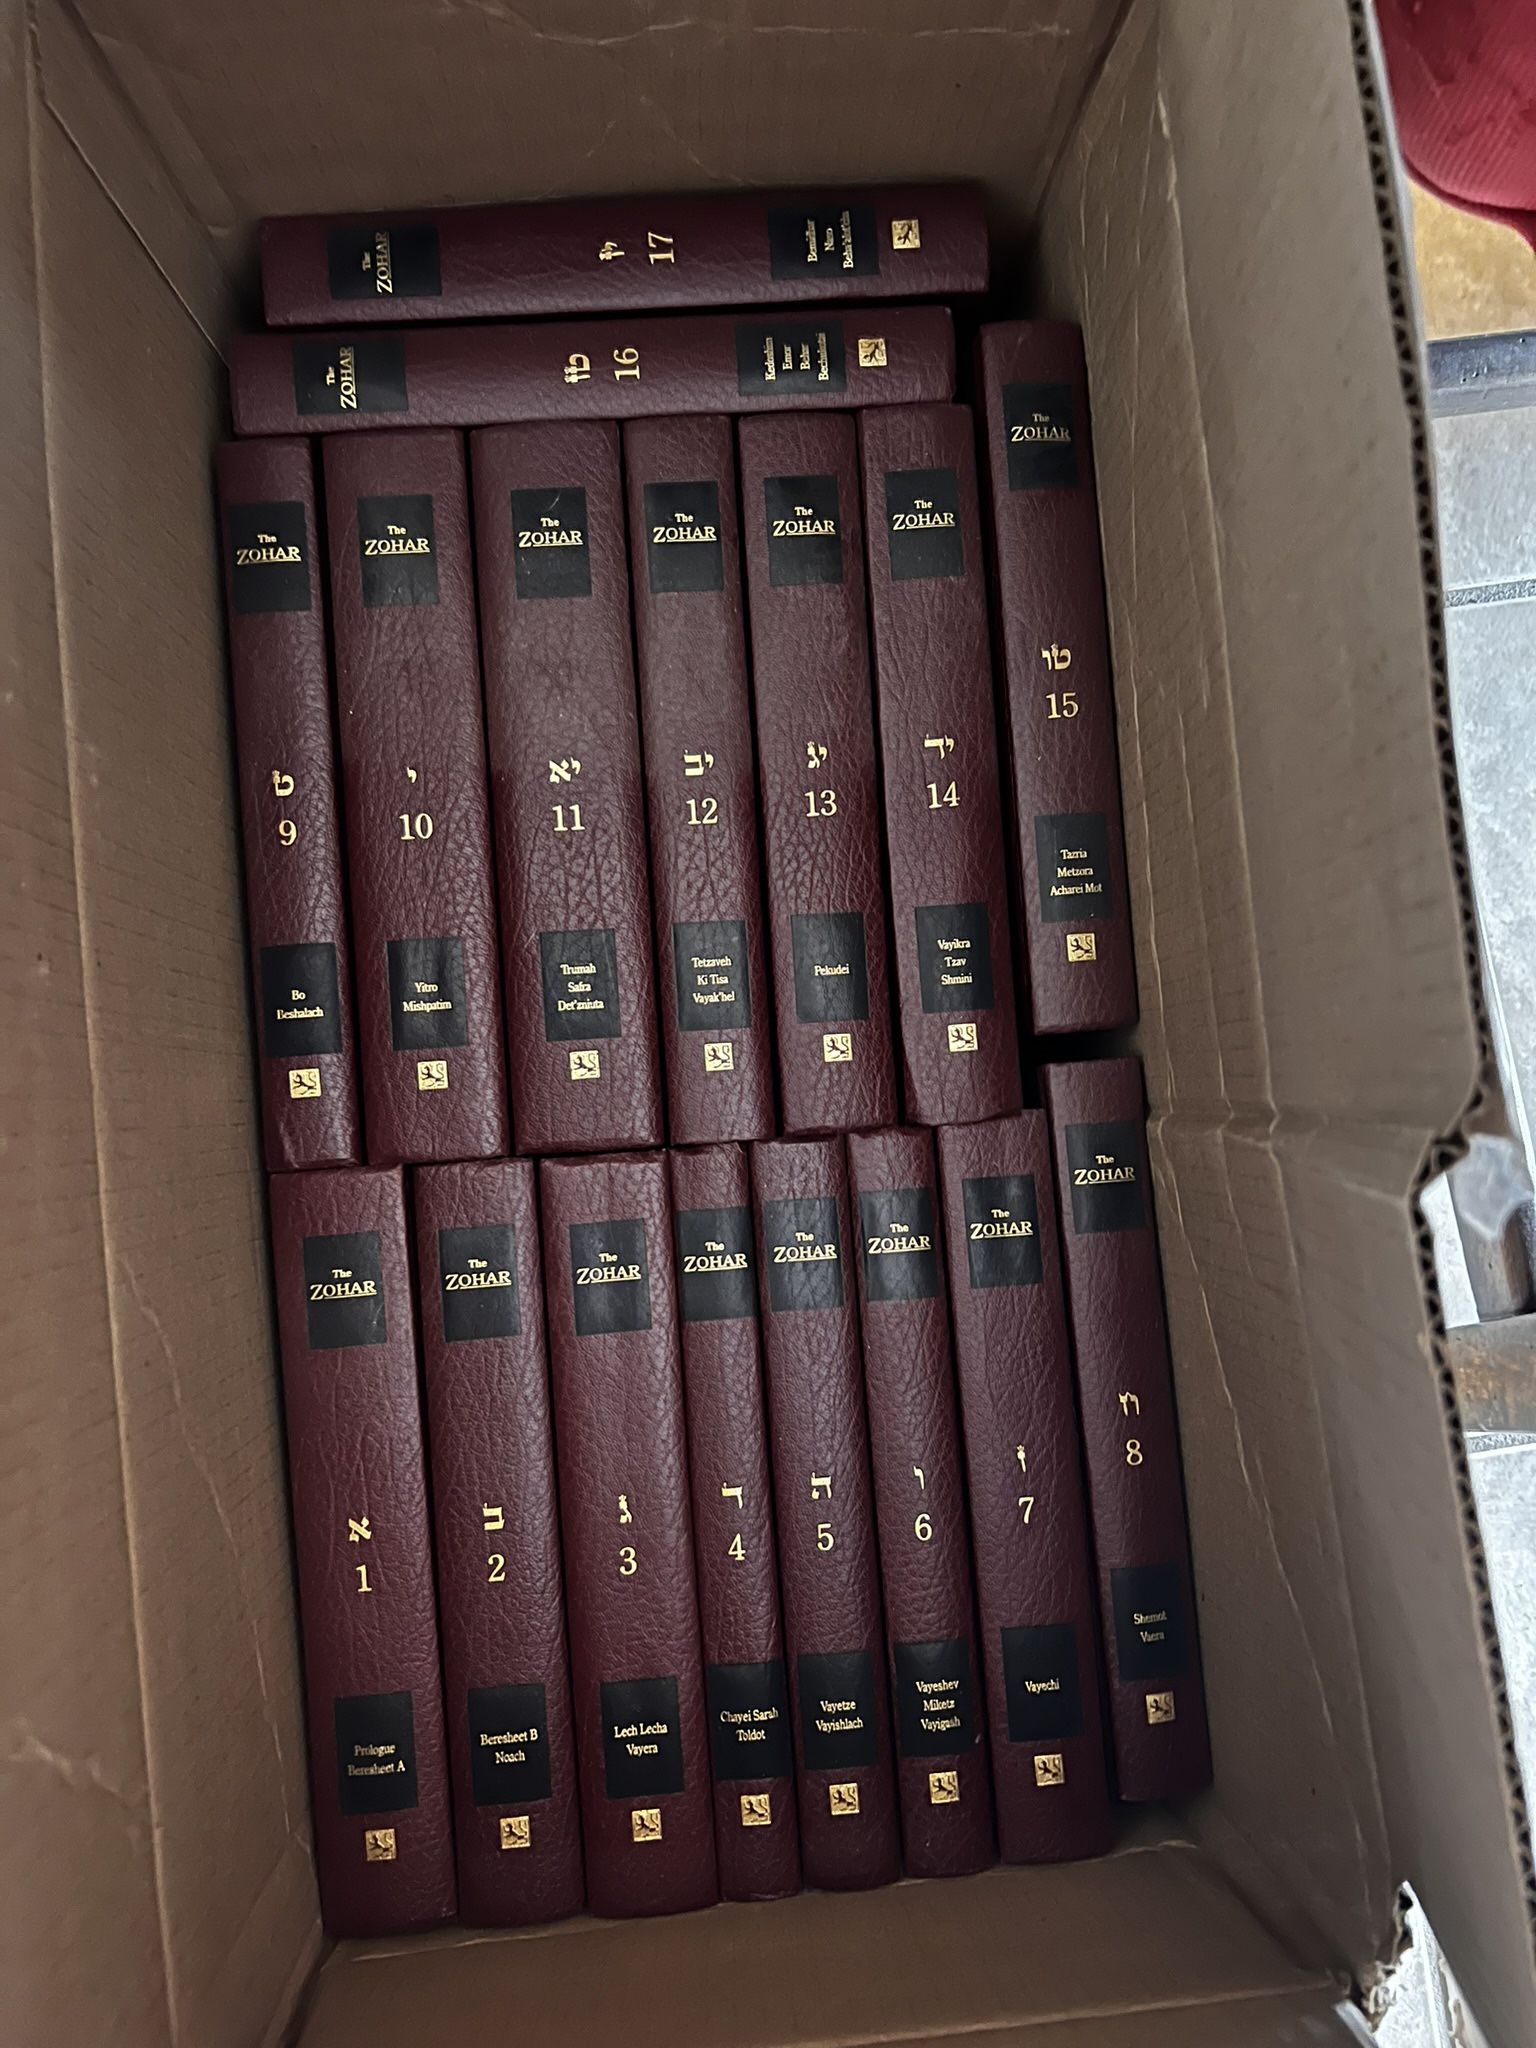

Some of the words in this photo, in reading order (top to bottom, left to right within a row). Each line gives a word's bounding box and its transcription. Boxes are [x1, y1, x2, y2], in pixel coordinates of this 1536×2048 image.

[647, 231, 675, 265] 17
[361, 251, 372, 272] The
[375, 232, 393, 294] ZOHAR
[612, 347, 641, 381] 16
[782, 343, 793, 371] Emor
[325, 365, 336, 387] The
[339, 346, 358, 409] ZOHAR
[1031, 412, 1050, 423] The
[1010, 425, 1071, 443] ZOHAR
[793, 506, 814, 517] The
[913, 499, 933, 510] The
[539, 517, 560, 528] The
[674, 512, 694, 523] The
[892, 512, 956, 531] ZOHAR
[386, 524, 407, 536] The
[652, 525, 718, 544] ZOHAR
[772, 519, 837, 537] ZOHAR
[256, 533, 278, 544] The
[364, 537, 431, 556] ZOHAR
[518, 530, 584, 548] ZOHAR
[236, 545, 302, 566] ZOHAR
[1045, 691, 1079, 719] 15
[806, 740, 828, 769] יג
[923, 733, 955, 760] יד
[548, 756, 582, 785] יא
[683, 749, 715, 777] יב
[271, 769, 295, 797] ט
[406, 766, 418, 784] י
[804, 787, 838, 817] 13
[926, 780, 961, 809] 14
[551, 803, 586, 832] 11
[685, 797, 720, 827] 12
[278, 817, 297, 846] 9
[398, 812, 434, 841] 10
[1059, 847, 1088, 860] Tazria
[1056, 866, 1094, 878] Metzora
[1049, 884, 1084, 897] Acharei
[1084, 882, 1103, 894] Mot
[936, 938, 972, 952] Vayikra
[559, 962, 597, 976] Trumah
[690, 955, 732, 969] Tetzaveh
[813, 962, 850, 977] Pekudei
[943, 956, 967, 968] Tzav
[413, 981, 439, 994] Yitro
[567, 980, 592, 993] Safra
[696, 974, 709, 986] Ki
[708, 973, 729, 985] Tisa
[940, 972, 973, 986] Shmini
[290, 989, 307, 1001] Bo
[402, 998, 453, 1013] Mishpatim
[1095, 1154, 1115, 1165] The
[1073, 1166, 1136, 1186] ZOHAR
[990, 1208, 1011, 1219] The
[794, 1231, 815, 1242] The
[889, 1223, 910, 1234] The
[969, 1220, 1034, 1240] ZOHAR
[704, 1239, 725, 1252] The
[773, 1243, 838, 1264] ZOHAR
[867, 1235, 932, 1255] ZOHAR
[467, 1258, 488, 1269] The
[597, 1252, 618, 1263] The
[683, 1253, 748, 1273] ZOHAR
[331, 1268, 353, 1279] The
[444, 1270, 512, 1291] ZOHAR
[576, 1264, 642, 1285] ZOHAR
[309, 1280, 378, 1301] ZOHAR
[1118, 1391, 1140, 1417] ח
[1016, 1444, 1027, 1473] ז
[1125, 1438, 1144, 1466] 8
[810, 1471, 832, 1500] ה
[913, 1465, 925, 1490] ו
[721, 1481, 747, 1510] ד
[481, 1502, 505, 1531] ב
[617, 1494, 633, 1524] ג
[1018, 1496, 1035, 1525] 7
[347, 1515, 372, 1544] א
[914, 1513, 933, 1542] 6
[727, 1532, 748, 1561] 4
[817, 1523, 835, 1552] 5
[487, 1553, 506, 1583] 2
[618, 1546, 638, 1576] 3
[355, 1564, 373, 1593] 1
[915, 1678, 960, 1695] Vayeshev
[1024, 1677, 1060, 1695] Vayechi
[819, 1700, 857, 1715] Vayetze
[922, 1698, 956, 1712] Miketz
[719, 1709, 753, 1725] Chayei
[752, 1706, 779, 1722] Sarah
[815, 1716, 864, 1734] Vayishlach
[919, 1715, 961, 1733] Vayigash
[479, 1730, 529, 1747] Beresheet
[528, 1727, 539, 1742] B
[613, 1723, 639, 1739] Lech
[638, 1721, 669, 1736] Lecha
[735, 1728, 767, 1742] Toldot
[354, 1743, 396, 1758] Prologue
[494, 1749, 526, 1765] Noach
[625, 1742, 659, 1758] Vayera
[396, 1759, 406, 1773] A
